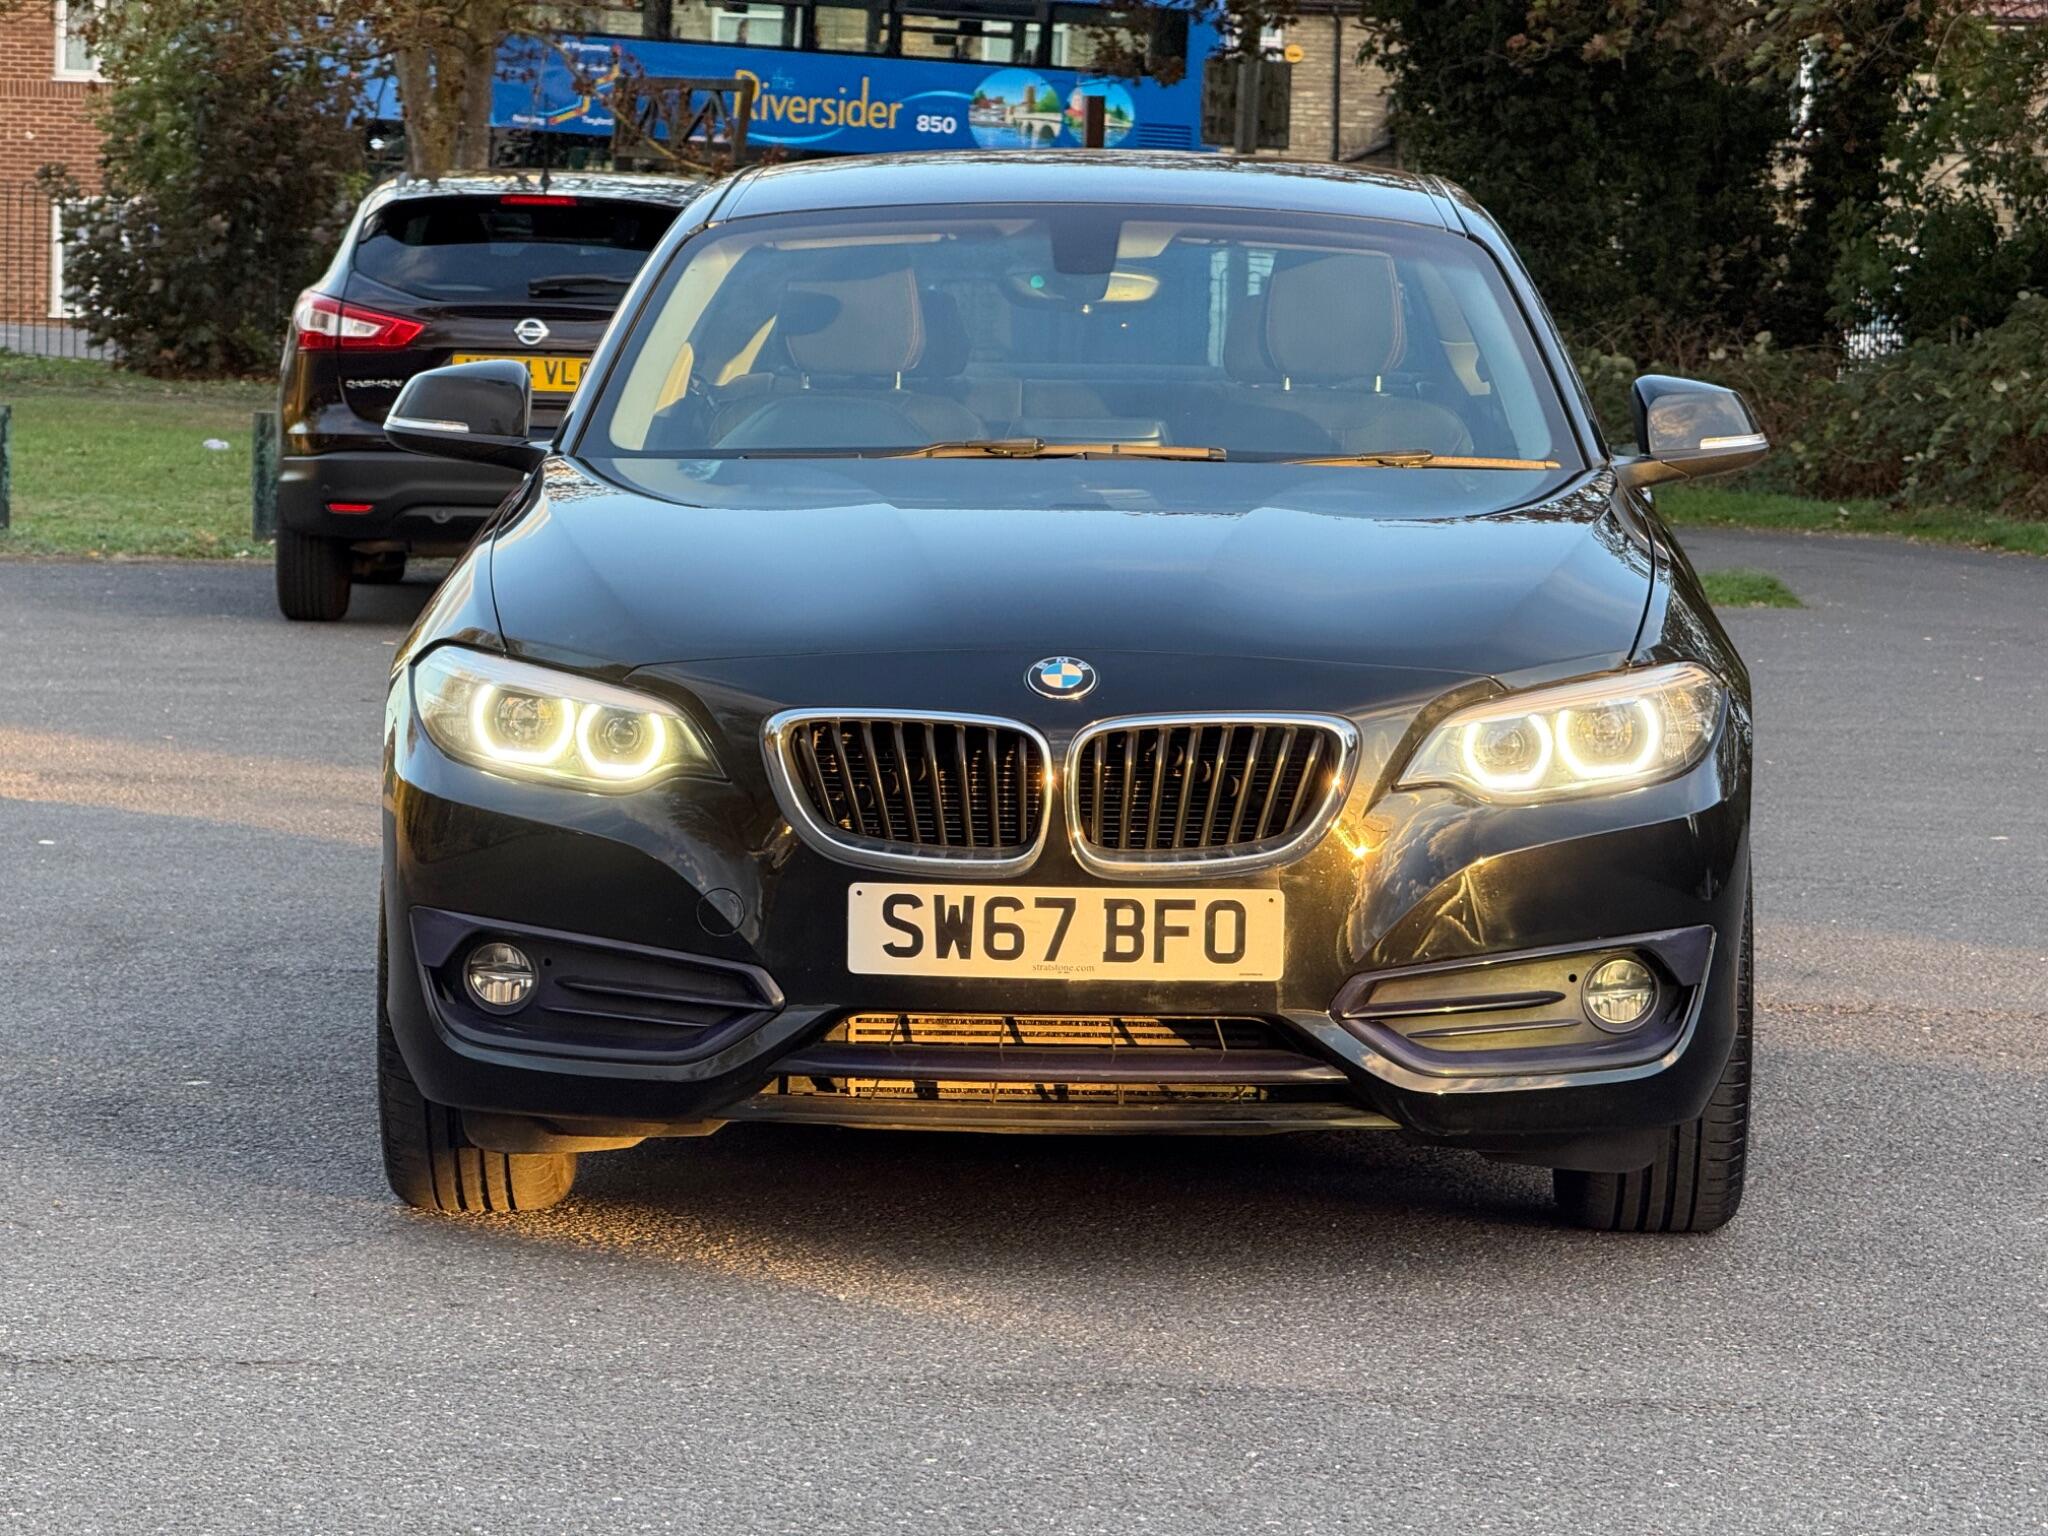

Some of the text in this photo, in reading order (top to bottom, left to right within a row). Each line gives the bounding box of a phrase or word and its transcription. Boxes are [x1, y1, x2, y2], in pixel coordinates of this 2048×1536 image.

[733, 69, 903, 129] Riversider
[916, 115, 957, 134] 850
[882, 893, 1247, 965] SW67 BFO
